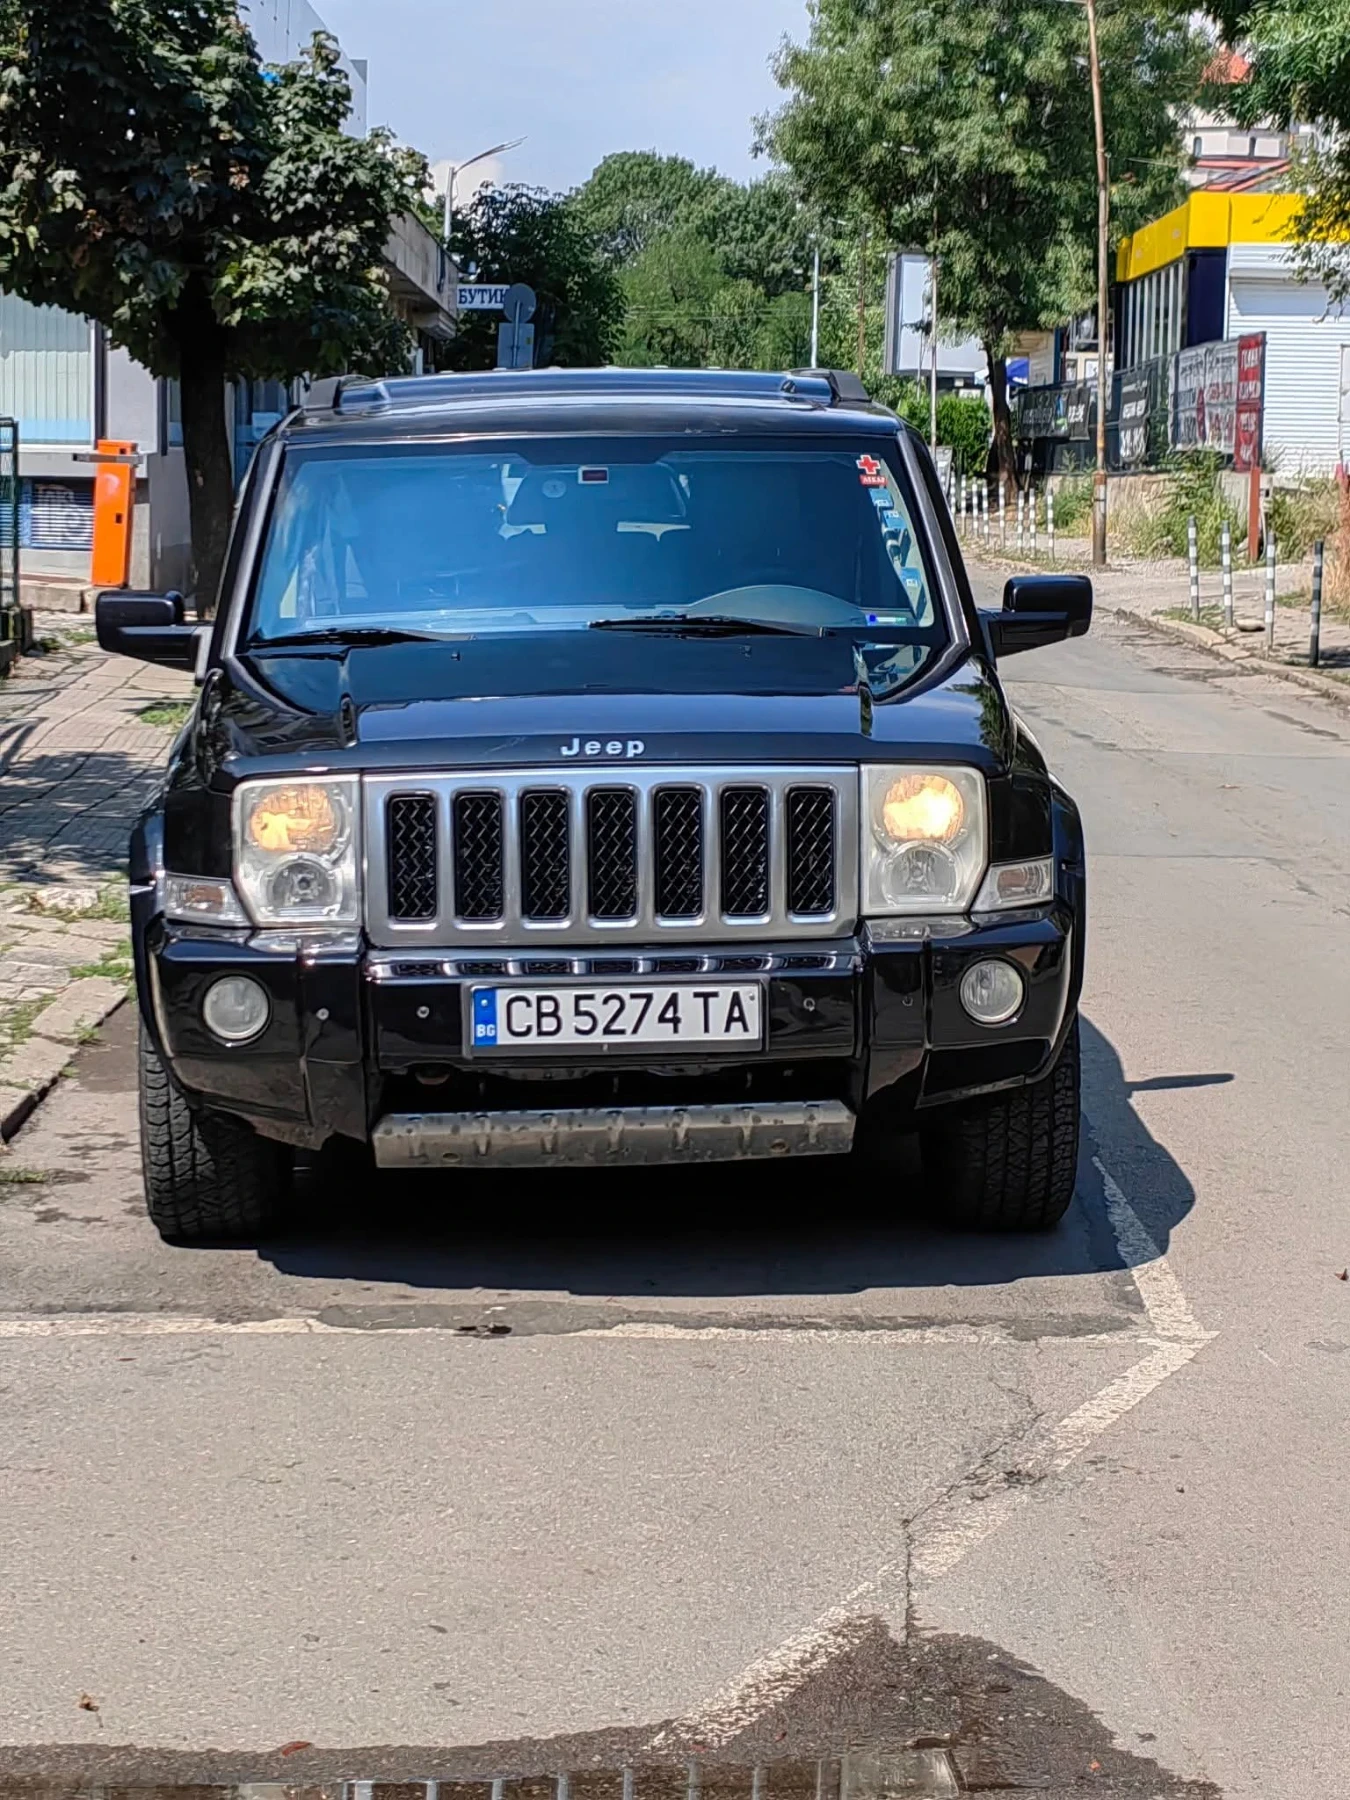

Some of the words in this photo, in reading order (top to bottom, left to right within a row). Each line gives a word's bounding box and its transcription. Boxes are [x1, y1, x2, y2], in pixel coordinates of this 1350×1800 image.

[561, 738, 645, 758] Jeep
[505, 993, 563, 1037] CB
[573, 992, 682, 1036] 5274
[693, 991, 750, 1034] TA
[476, 1023, 496, 1037] BG
